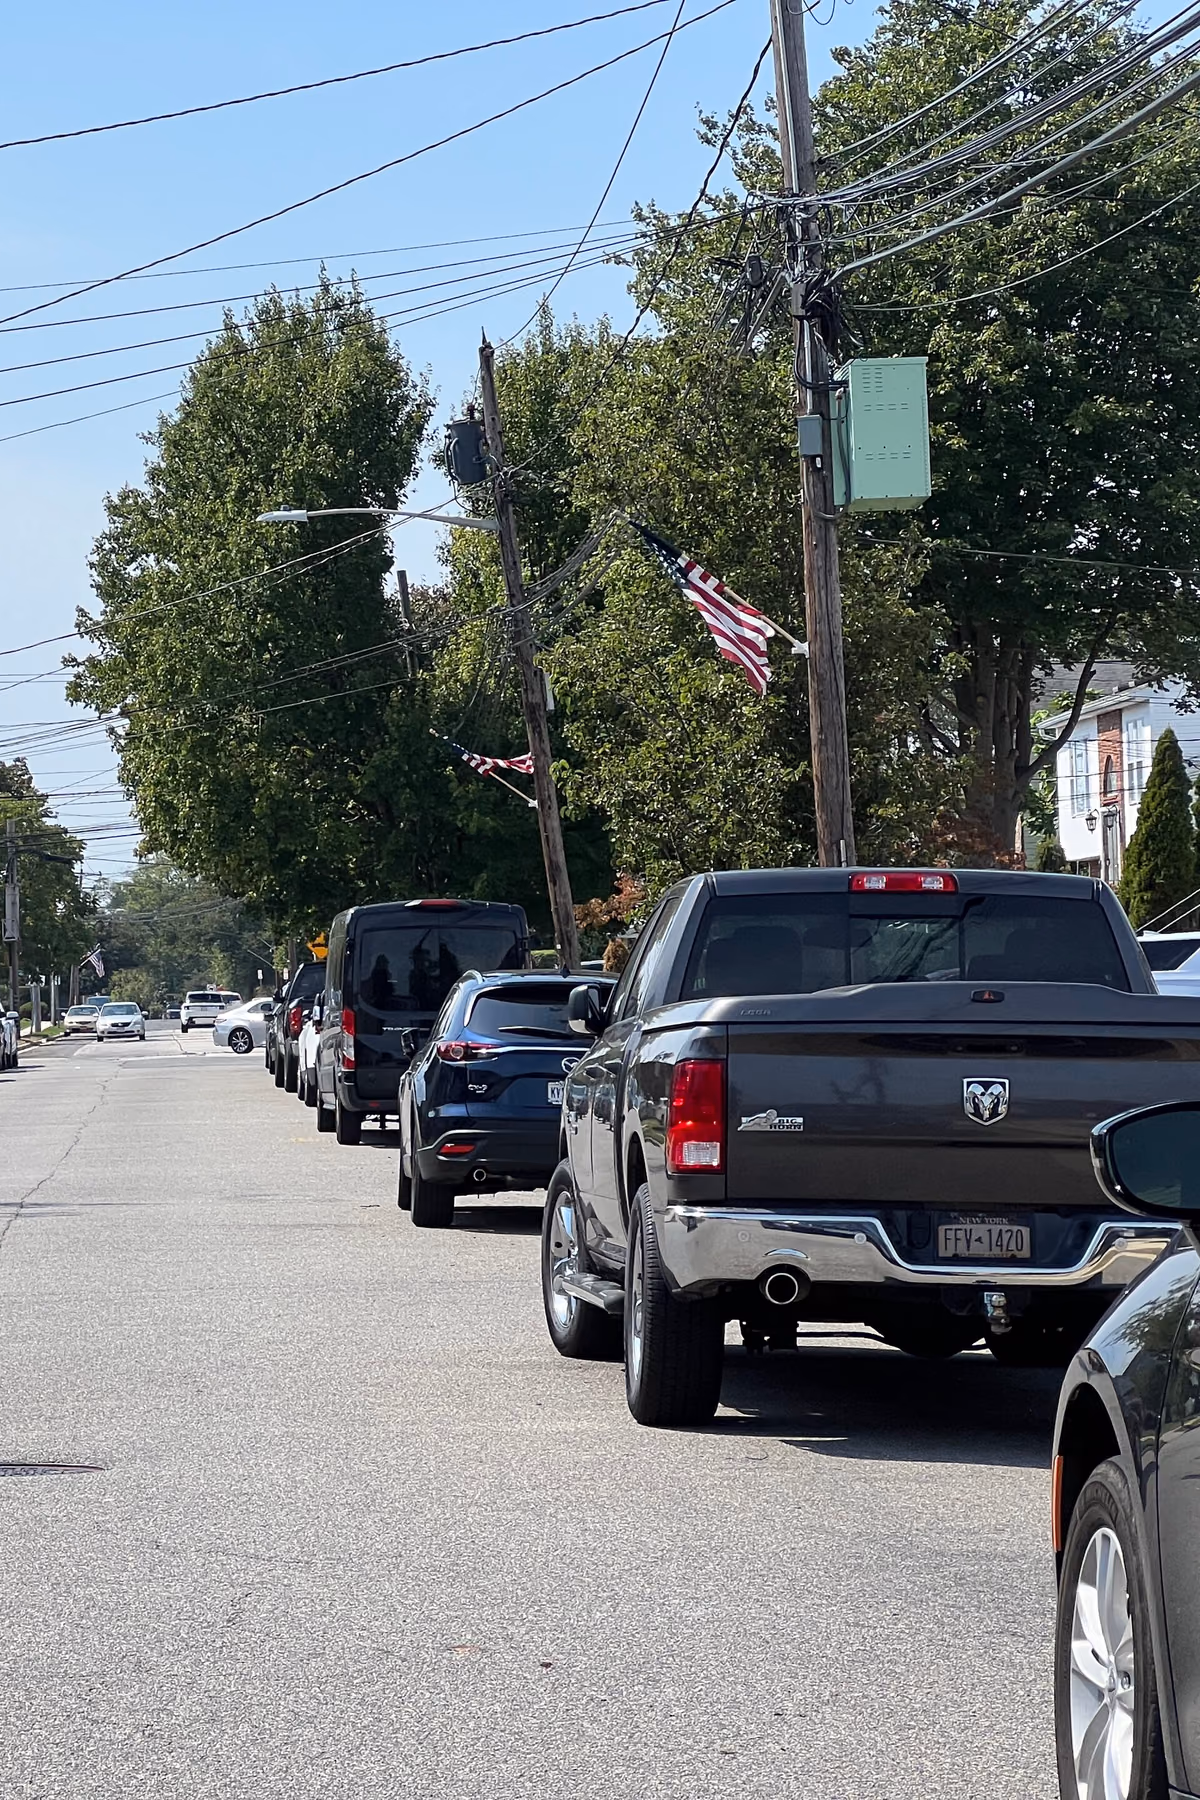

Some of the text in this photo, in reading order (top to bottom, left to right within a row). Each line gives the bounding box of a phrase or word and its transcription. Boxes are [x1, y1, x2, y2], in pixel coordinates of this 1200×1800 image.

[550, 1087, 563, 1099] KY
[959, 1217, 1009, 1225] NEW YORK
[944, 1228, 1024, 1252] FFV 1420
